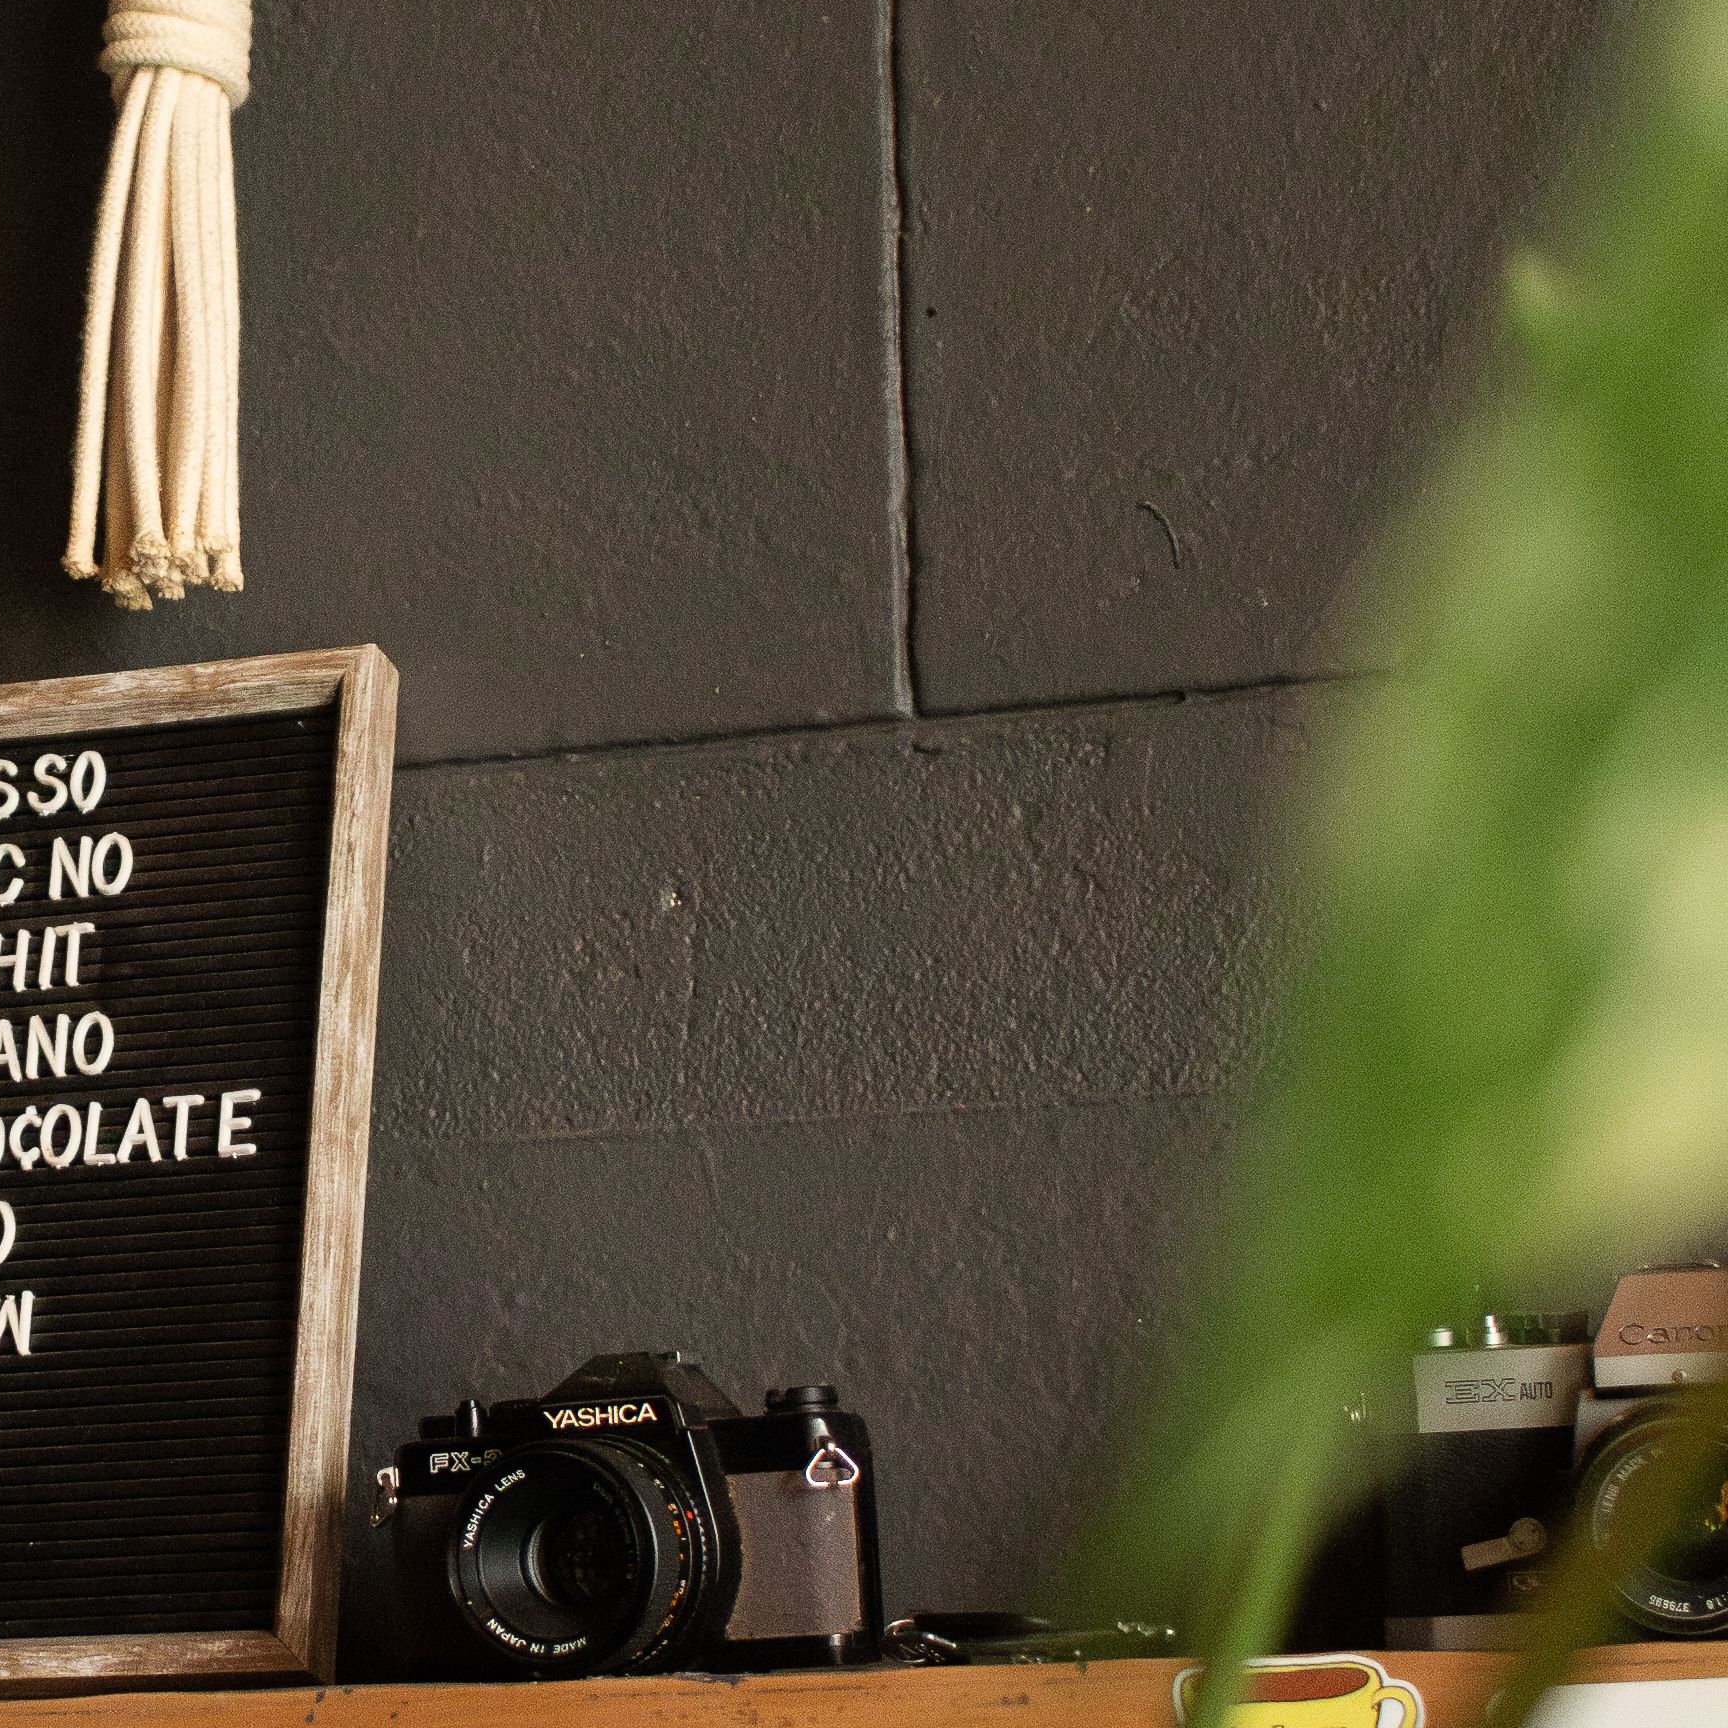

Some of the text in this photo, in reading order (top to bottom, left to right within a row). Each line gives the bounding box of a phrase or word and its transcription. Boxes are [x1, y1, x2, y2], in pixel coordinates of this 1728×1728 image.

[49, 831, 134, 902] NO
[1445, 1378, 1553, 1404] EX AUTO
[543, 1402, 658, 1430] YASHICA
[463, 1468, 527, 1549] YASHICA LENS
[485, 1617, 588, 1655] MADE IN JAPAN
